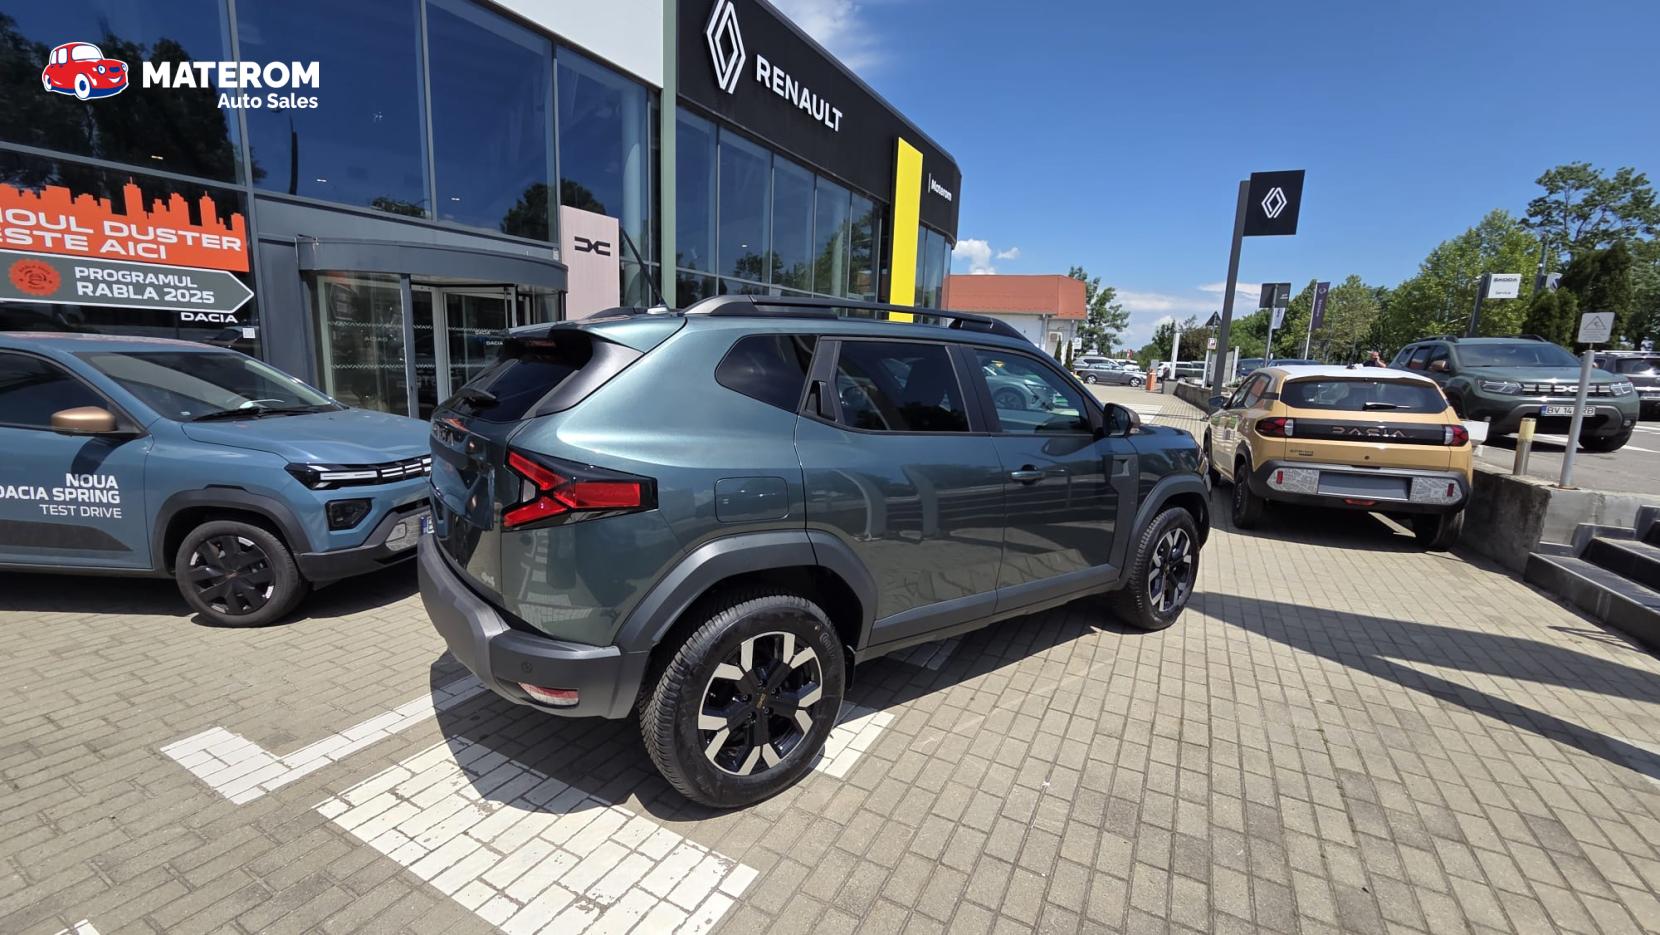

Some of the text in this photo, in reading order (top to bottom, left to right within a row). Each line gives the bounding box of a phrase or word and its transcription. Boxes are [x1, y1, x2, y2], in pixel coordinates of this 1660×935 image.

[756, 54, 843, 132] RENAULT
[0, 207, 242, 252] OUL DUSTER
[0, 227, 167, 260] STE AICI
[74, 266, 198, 288] PROGRAMUL
[76, 281, 215, 304] RABLA 2025
[180, 311, 238, 324] DACIA
[1547, 406, 1560, 414] BV
[1331, 426, 1407, 438] DACIA
[65, 473, 119, 488] NOUA
[52, 487, 120, 504] SPRING
[39, 504, 122, 519] TEST DRIVE
